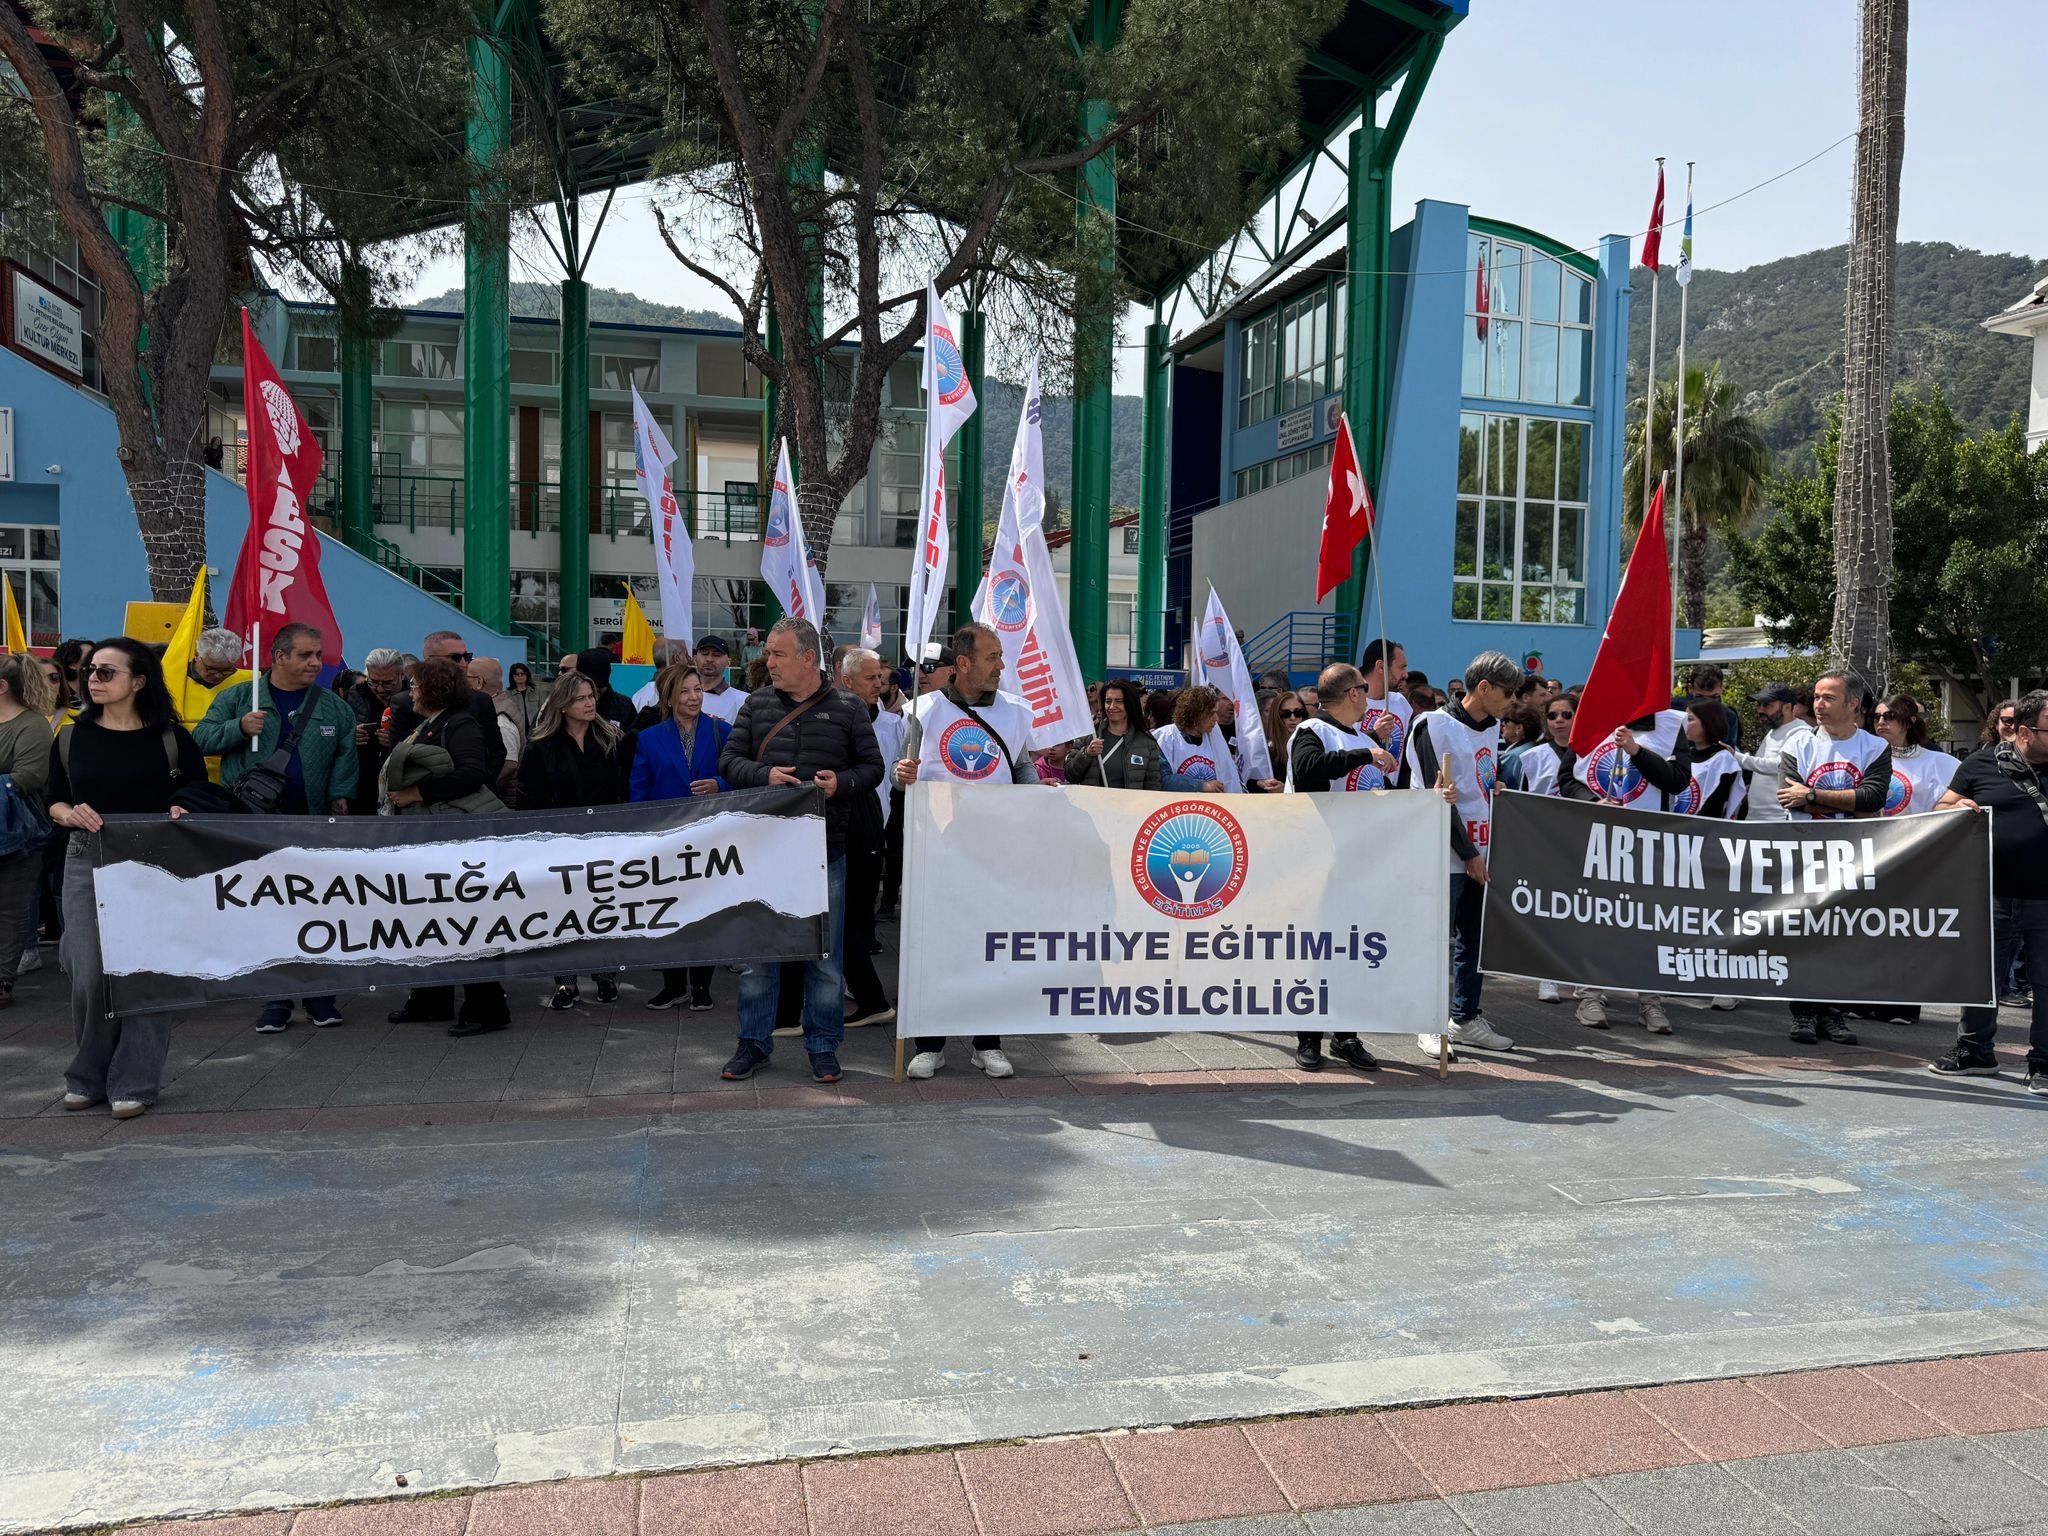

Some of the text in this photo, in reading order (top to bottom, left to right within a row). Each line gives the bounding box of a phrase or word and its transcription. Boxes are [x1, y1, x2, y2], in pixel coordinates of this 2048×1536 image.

[593, 616, 623, 626] SERGİ
[1133, 803, 1245, 892] EĞİTİM VE BİLİM İŞGÖRENLERİ SENDİKASI
[1583, 823, 1877, 894] ARTIK YETER!
[215, 845, 744, 911] KARANLIĞA TESLİM
[298, 895, 680, 955] OLMAYACAĞIZ
[1152, 897, 1223, 917] EĞİTİM-İŞ
[1512, 878, 1725, 936] ÖLDÜRÜLMEK
[985, 923, 1388, 969] FETHİYE EĞİTİM-İŞ
[1657, 945, 1789, 986] Eğitimiş
[1042, 978, 1329, 1017] TEMSİLCİLİĞİ
